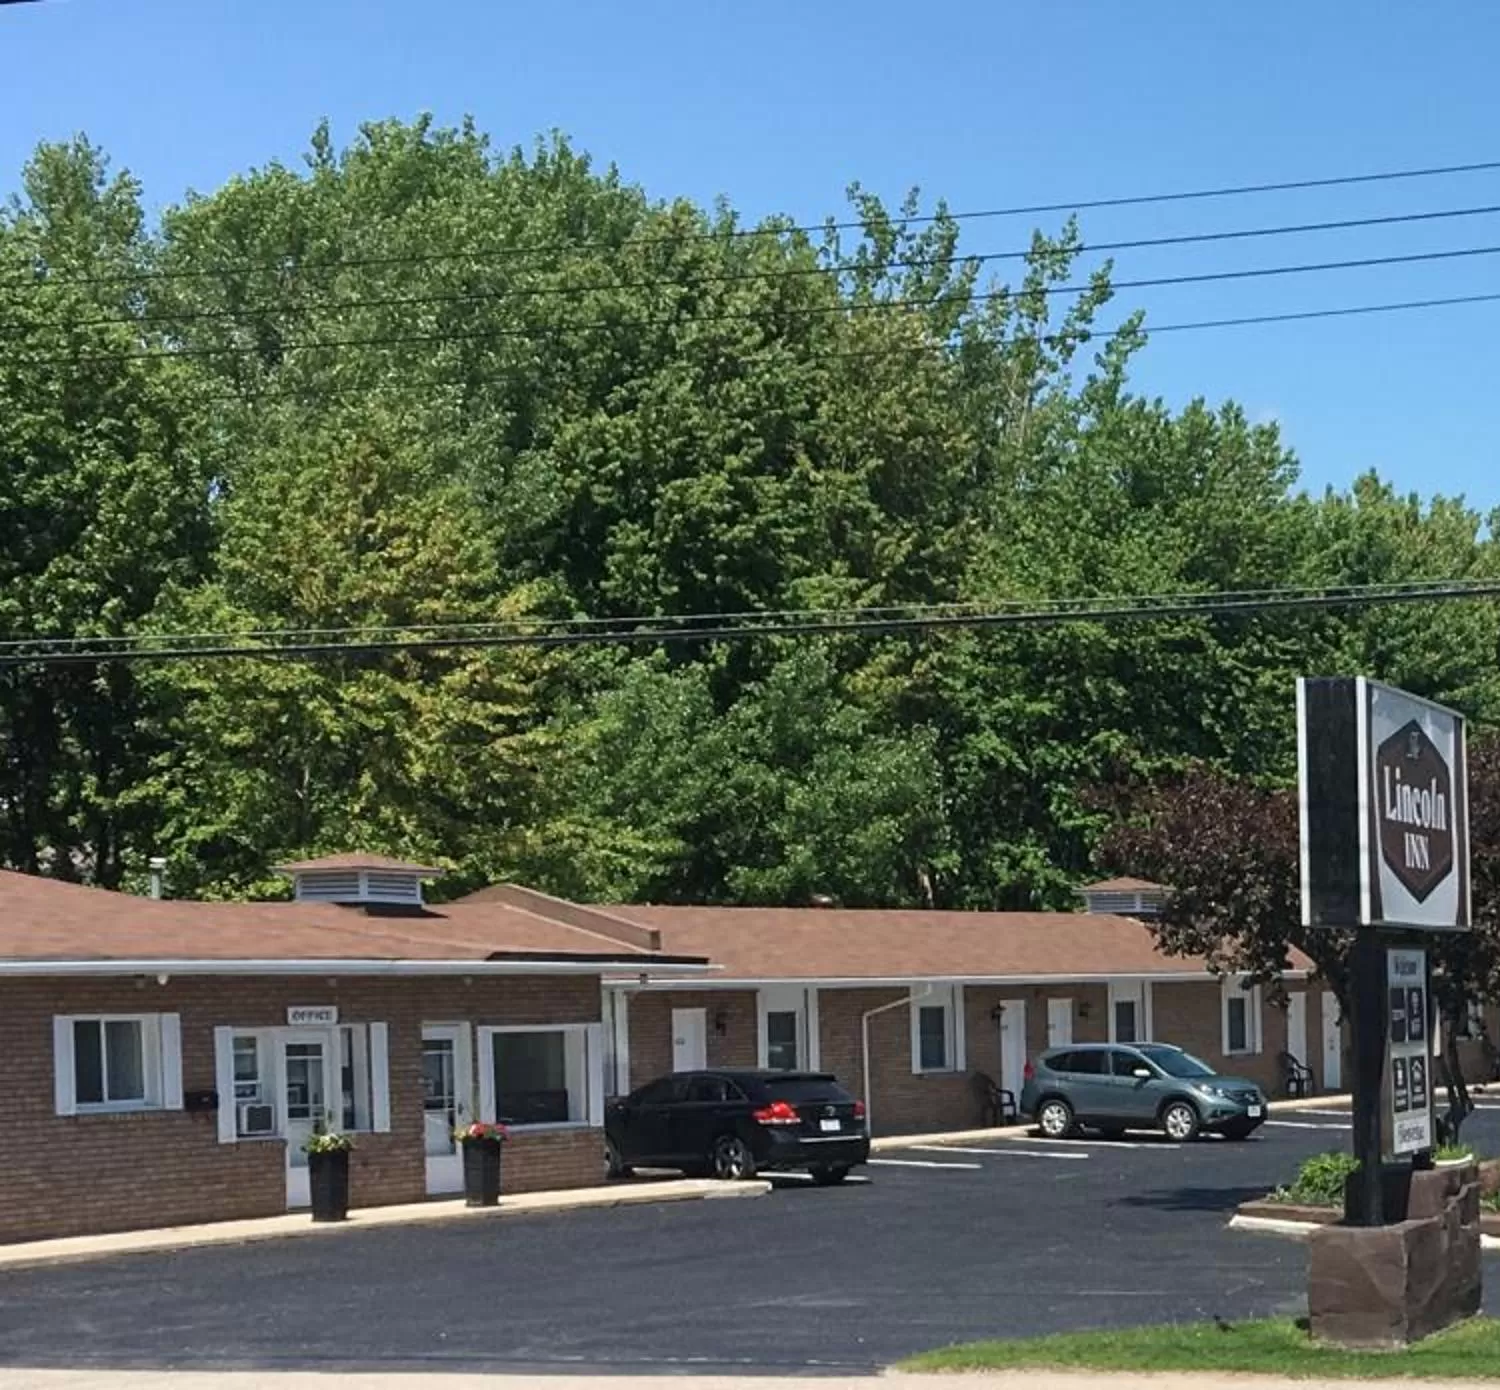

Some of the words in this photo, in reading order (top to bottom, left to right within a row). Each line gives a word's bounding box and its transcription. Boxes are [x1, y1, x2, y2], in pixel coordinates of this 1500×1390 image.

[1383, 764, 1447, 831] Lincoln
[1404, 832, 1430, 871] INN
[291, 1010, 332, 1021] OFFICE
